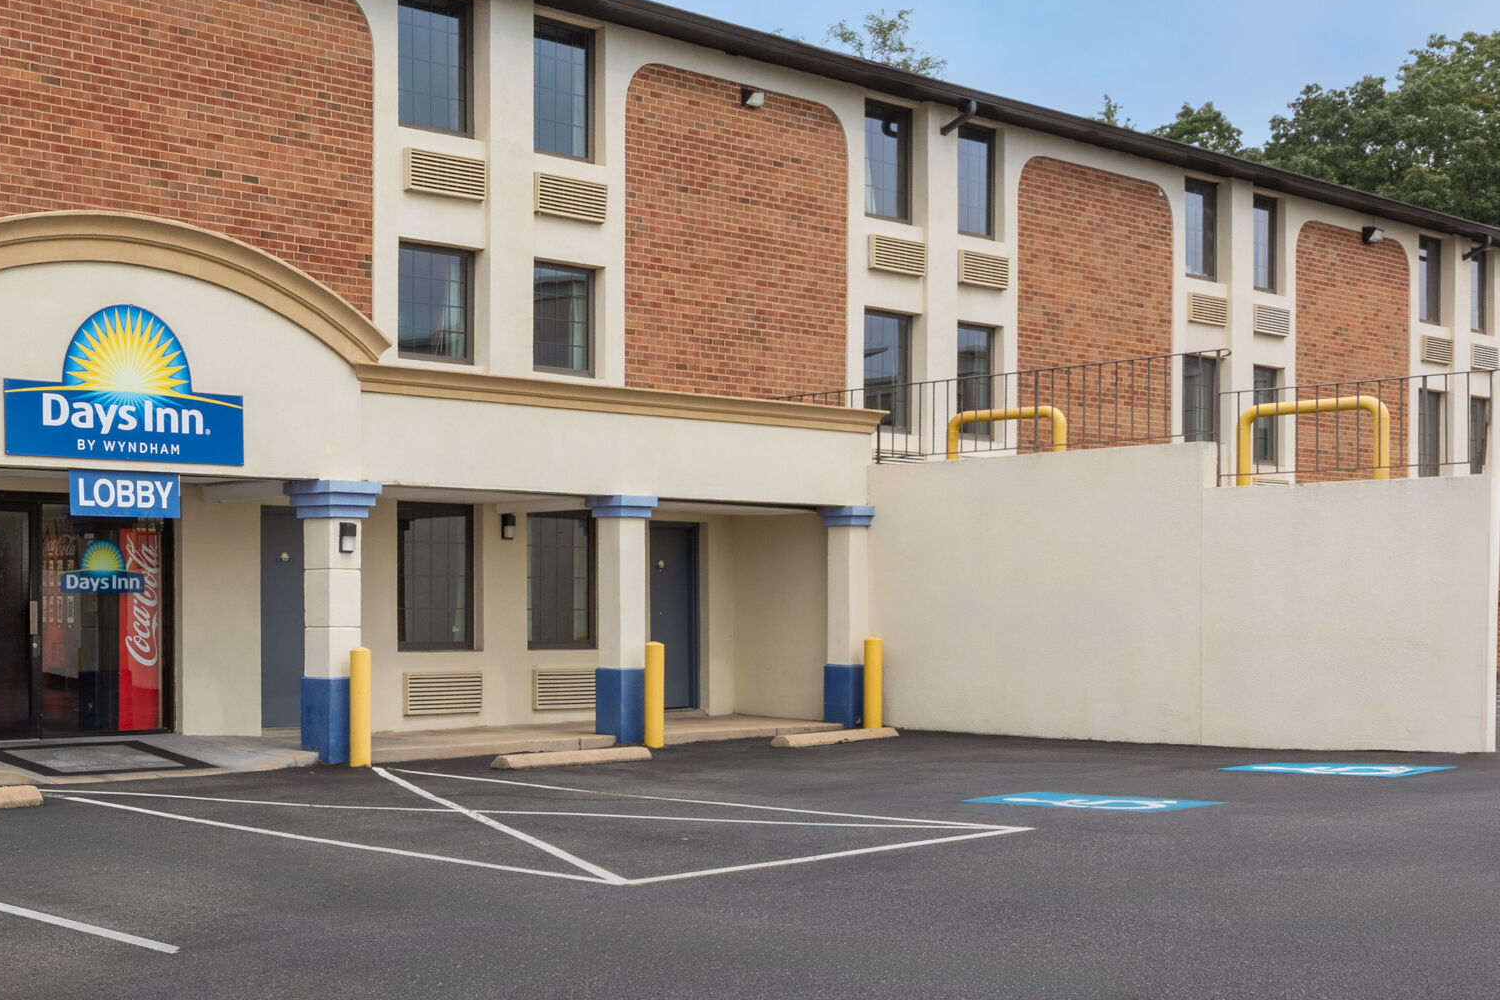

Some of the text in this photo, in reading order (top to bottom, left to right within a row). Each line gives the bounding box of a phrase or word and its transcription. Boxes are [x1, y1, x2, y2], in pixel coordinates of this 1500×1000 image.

[42, 392, 204, 435] Days Inn
[77, 438, 181, 455] BY WYNDHAM
[78, 477, 174, 509] LOBBY
[65, 574, 140, 592] Days Inn
